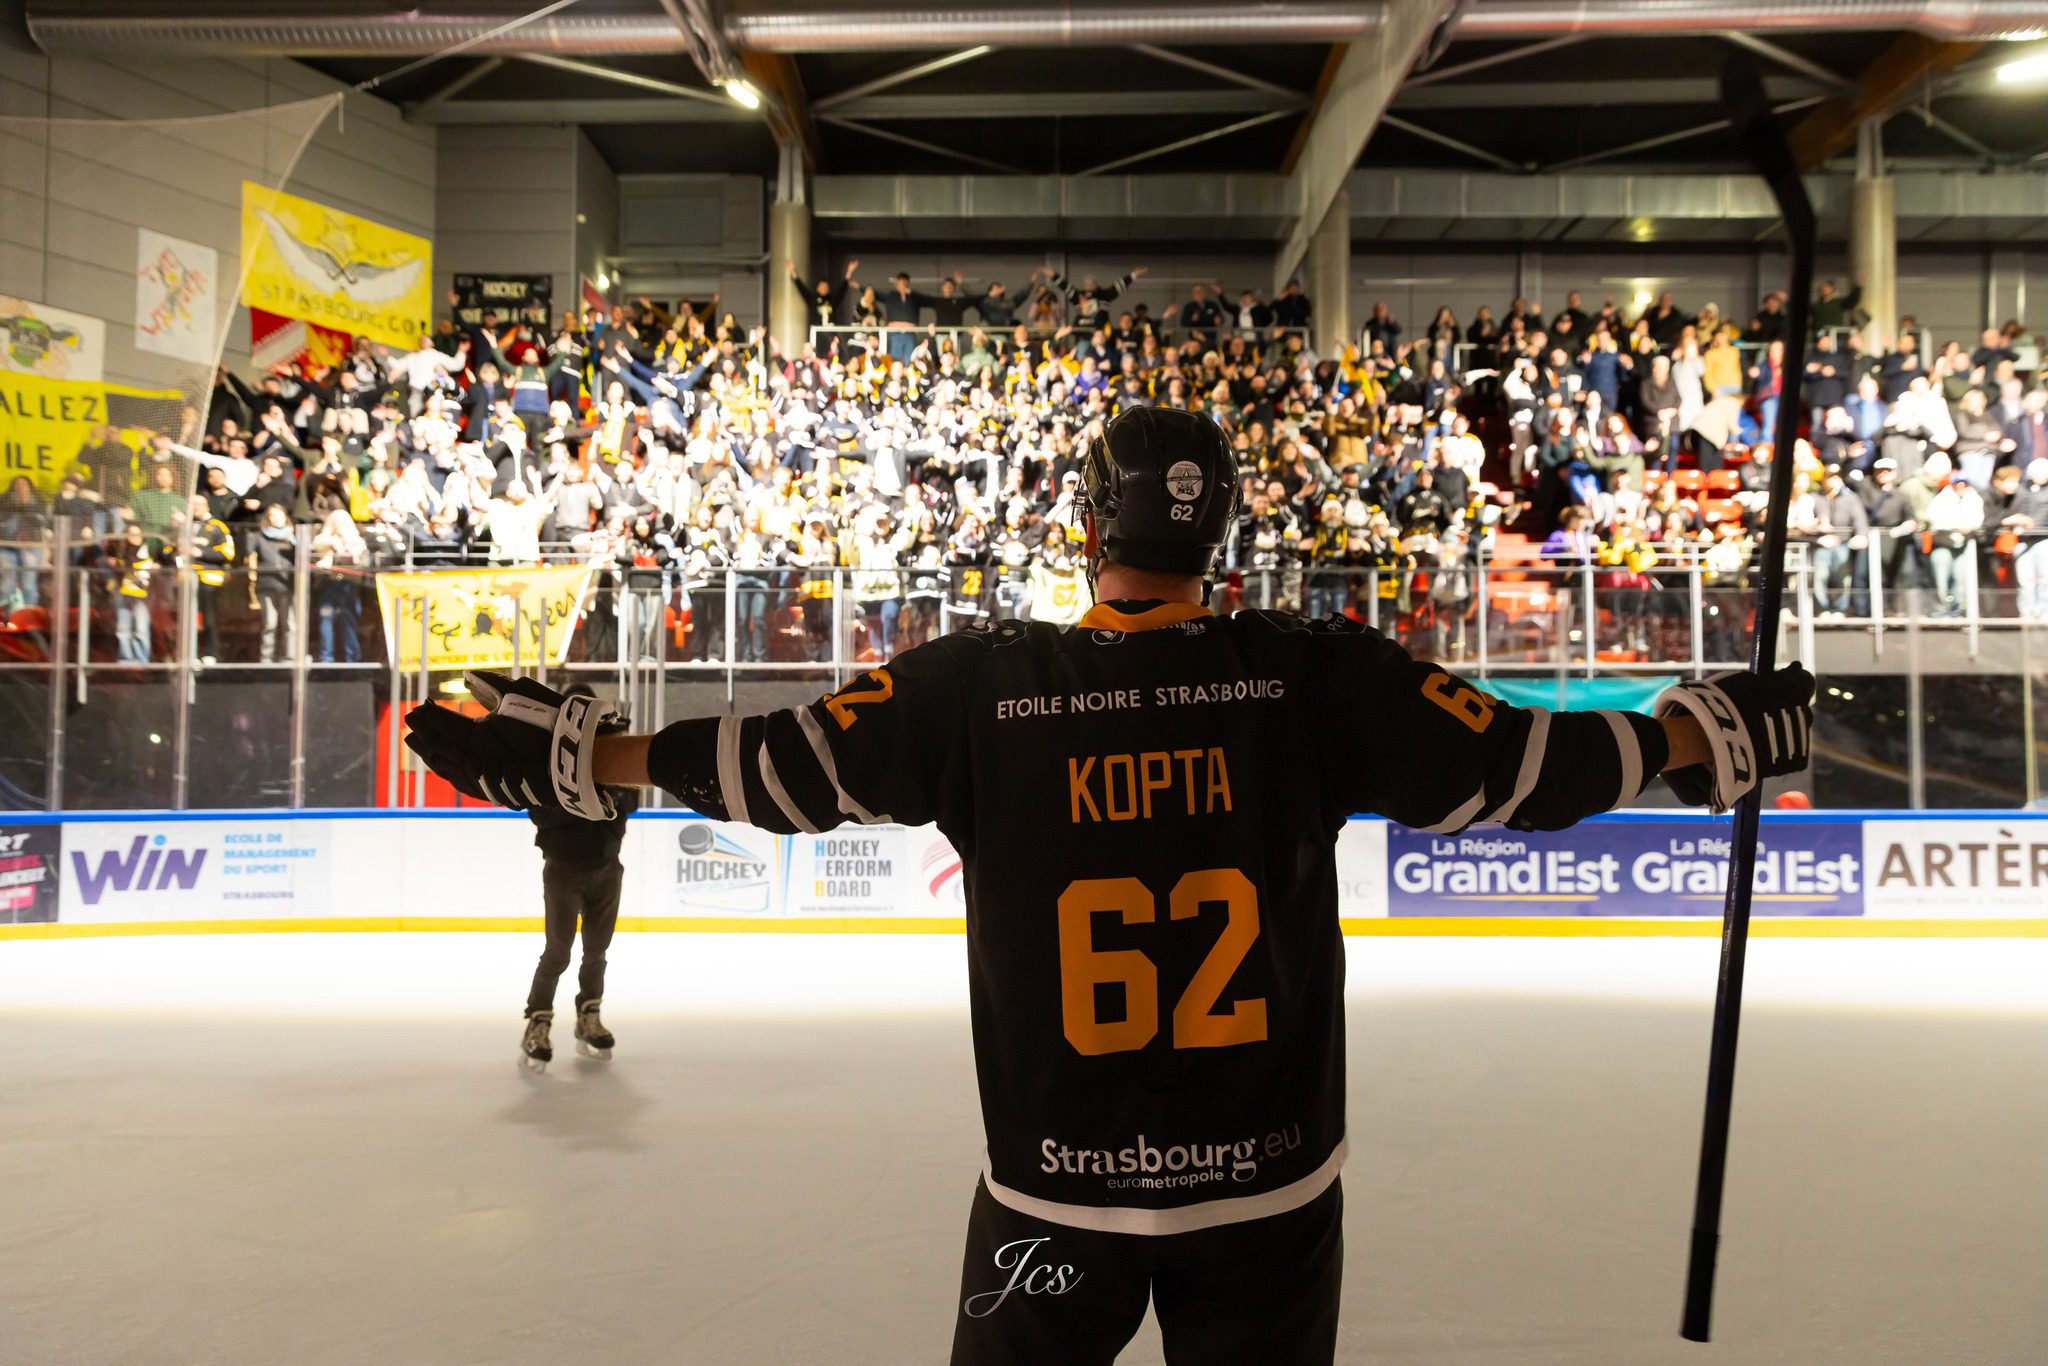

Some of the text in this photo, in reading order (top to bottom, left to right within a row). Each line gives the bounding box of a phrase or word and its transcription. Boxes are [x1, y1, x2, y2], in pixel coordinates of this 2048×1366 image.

[1170, 503, 1194, 521] 62
[824, 668, 894, 731] 2
[997, 678, 1285, 720] ETOILE NOIRE STRASBOURG
[1420, 672, 1497, 734] 6
[1068, 746, 1233, 823] KOPTA
[223, 848, 316, 859] MANAGEMENT
[815, 840, 880, 857] HOCKEY
[1431, 837, 1526, 858] La Région
[1669, 838, 1766, 859] La Régn
[245, 864, 288, 874] SPORT
[676, 858, 768, 884] HOCKEY
[815, 860, 892, 877] PERFORM
[815, 880, 872, 897] BOARD
[1056, 867, 1268, 1057] 62
[1040, 1122, 1302, 1182] Strasbourg.eu
[1107, 1168, 1224, 1190] eurometropole
